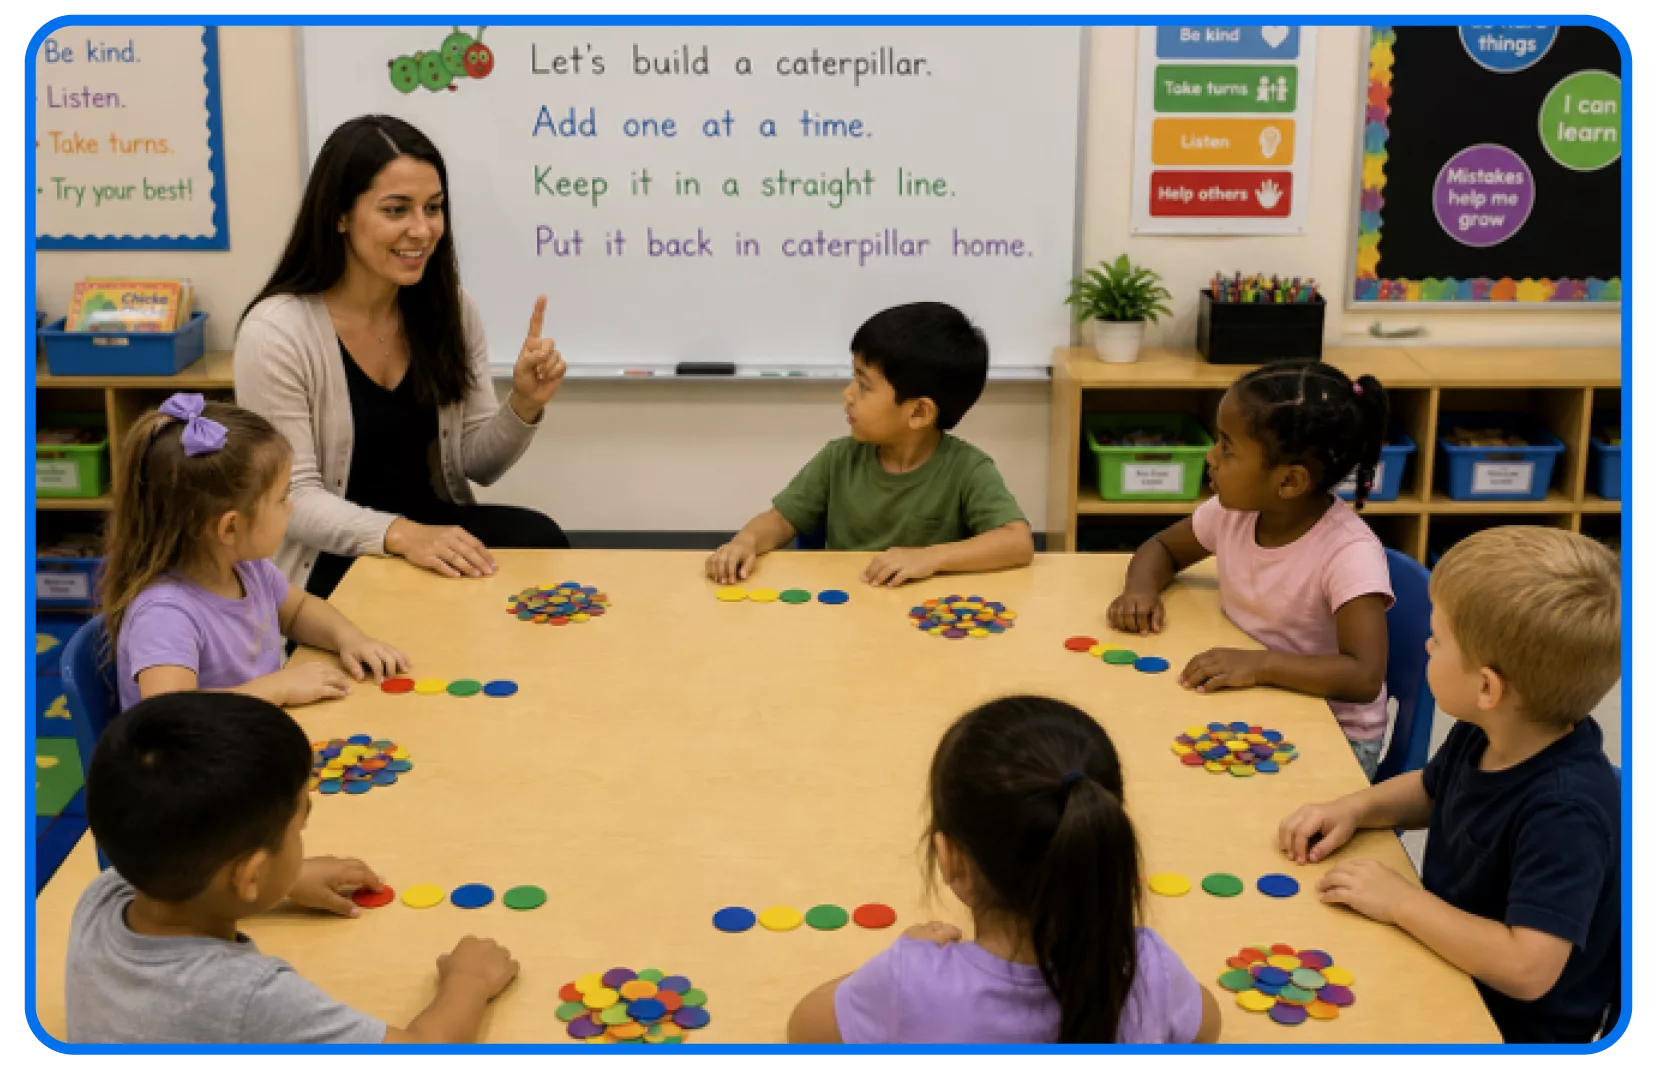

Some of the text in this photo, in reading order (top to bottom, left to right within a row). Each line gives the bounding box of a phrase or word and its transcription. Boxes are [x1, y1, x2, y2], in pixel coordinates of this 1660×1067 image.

[1179, 27, 1241, 43] Be kind
[1478, 33, 1537, 57] things
[44, 38, 142, 63] Be kind.
[531, 42, 932, 87] Let's build a caterpillar.
[46, 85, 127, 109] Listen.
[1164, 80, 1249, 97] Take turns
[1563, 94, 1618, 115] I can
[531, 104, 873, 139] Add one at a time.
[1557, 121, 1618, 142] learn
[48, 129, 175, 154] Take turns.
[1180, 134, 1230, 149] Listen
[534, 164, 956, 209] Keep it in a straight line.
[1447, 167, 1525, 185] Mistakes
[50, 176, 193, 207] Try your best!
[1158, 186, 1249, 204] Help others
[1448, 188, 1520, 209] help me
[1458, 213, 1506, 231] grow
[536, 224, 1033, 267] Put it back in caterpillar home.
